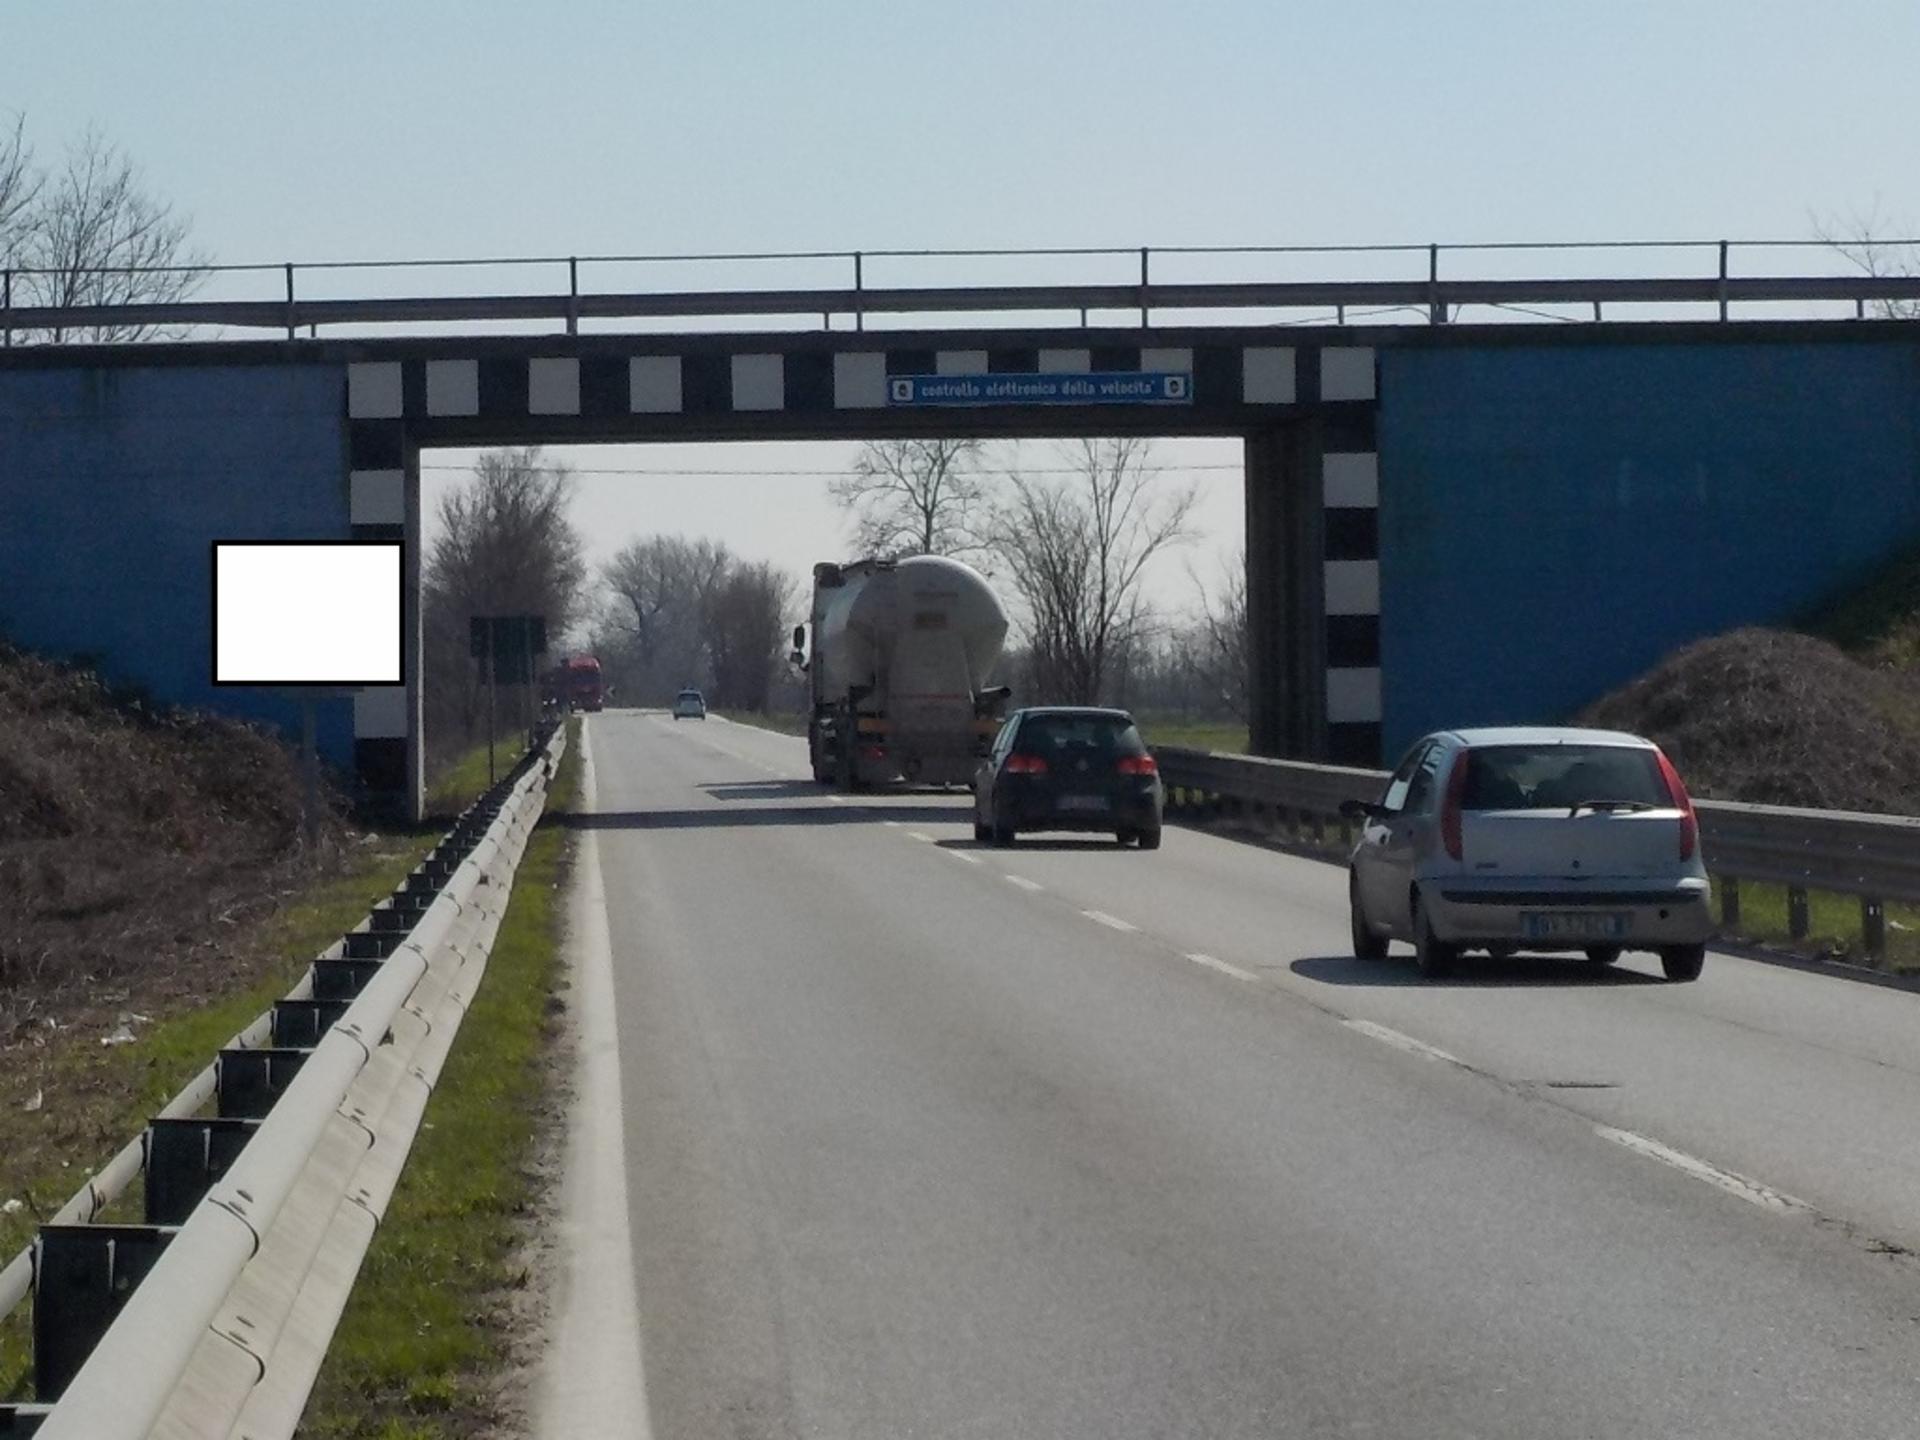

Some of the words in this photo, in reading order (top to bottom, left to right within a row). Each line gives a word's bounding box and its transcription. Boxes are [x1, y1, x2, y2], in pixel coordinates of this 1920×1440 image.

[921, 381, 980, 397] controllo
[985, 381, 1057, 396] elettronico
[1061, 380, 1096, 395] della
